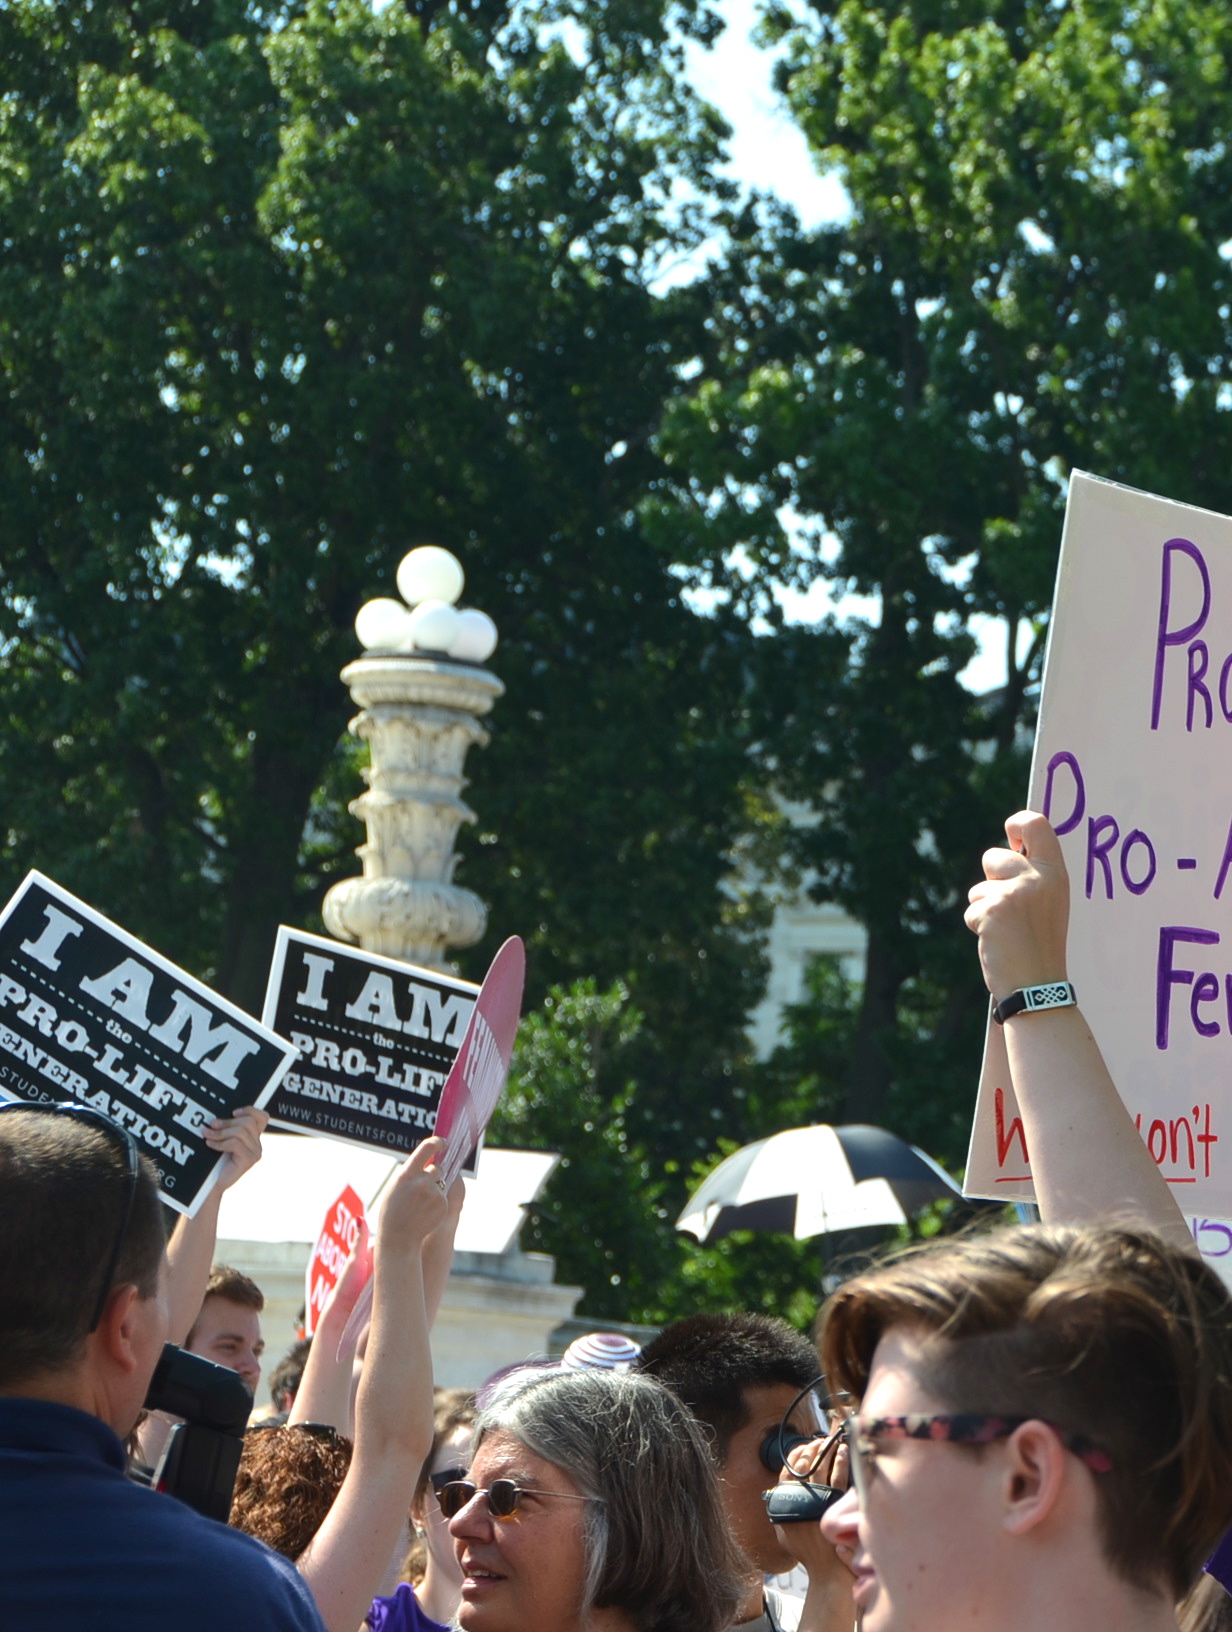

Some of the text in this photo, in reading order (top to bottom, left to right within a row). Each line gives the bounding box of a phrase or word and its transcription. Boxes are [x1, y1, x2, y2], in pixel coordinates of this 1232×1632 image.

[20, 904, 260, 1090] I AM
[296, 952, 478, 1049] I AM
[0, 973, 220, 1138] PRO-LIFE
[106, 1018, 132, 1044] the
[289, 1031, 447, 1097] PRO-LIF
[372, 1032, 394, 1050] the
[0, 1022, 195, 1166] ENERATION
[282, 1071, 438, 1130] GENERATIO
[1136, 1104, 1218, 1178] on't
[333, 1202, 359, 1251] STO
[778, 1492, 812, 1503] SONY
